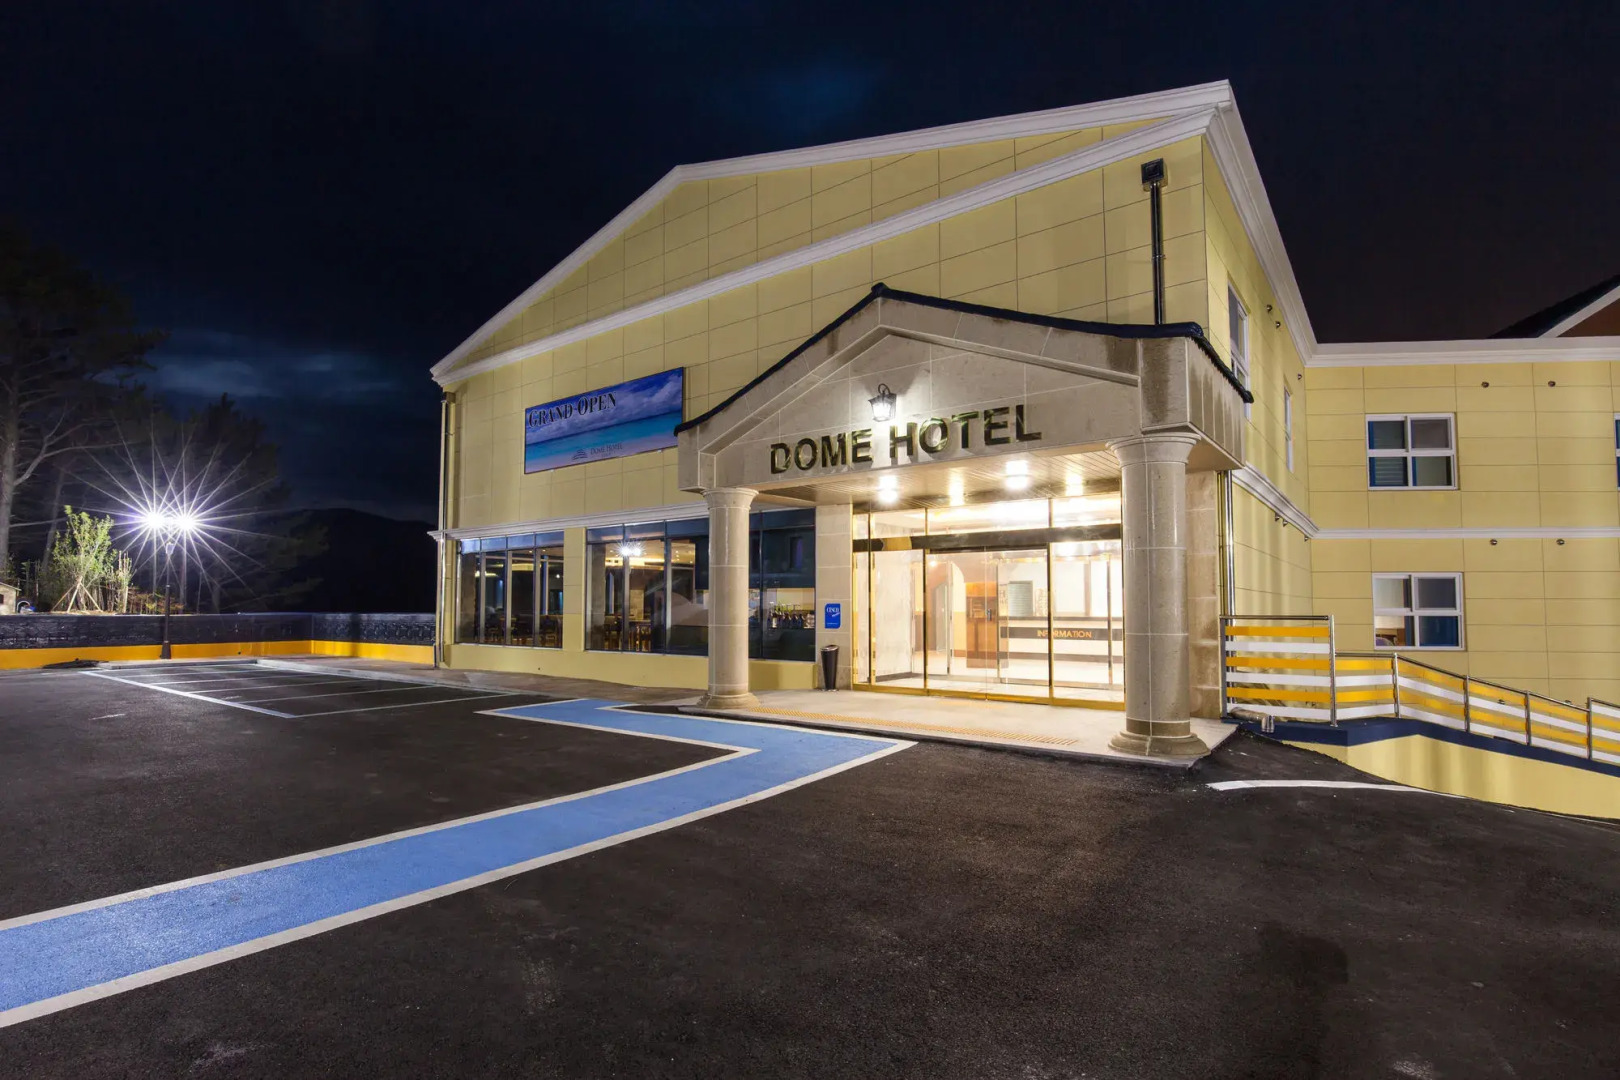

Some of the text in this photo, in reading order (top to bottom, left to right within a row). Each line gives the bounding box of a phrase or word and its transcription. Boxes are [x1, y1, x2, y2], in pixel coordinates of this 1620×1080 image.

[528, 391, 616, 427] GRAND OPEN
[771, 404, 1042, 474] DOME HOTEL
[1037, 630, 1092, 638] INFRMATION
